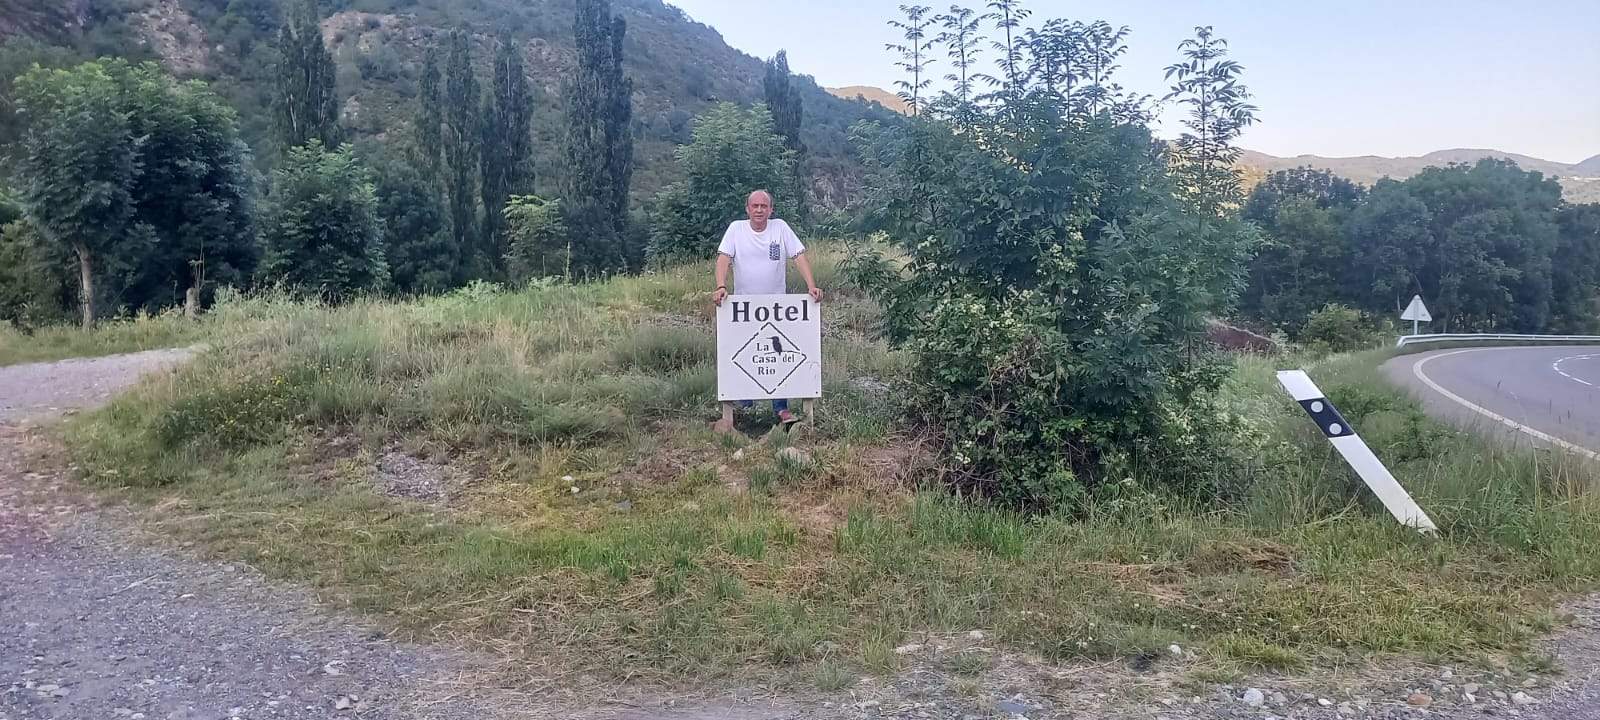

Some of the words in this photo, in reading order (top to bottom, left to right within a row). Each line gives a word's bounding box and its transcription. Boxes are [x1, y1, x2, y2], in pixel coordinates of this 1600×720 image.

[731, 299, 810, 322] Hotel
[756, 342, 769, 352] La
[752, 354, 777, 363] Casa
[782, 354, 795, 363] del
